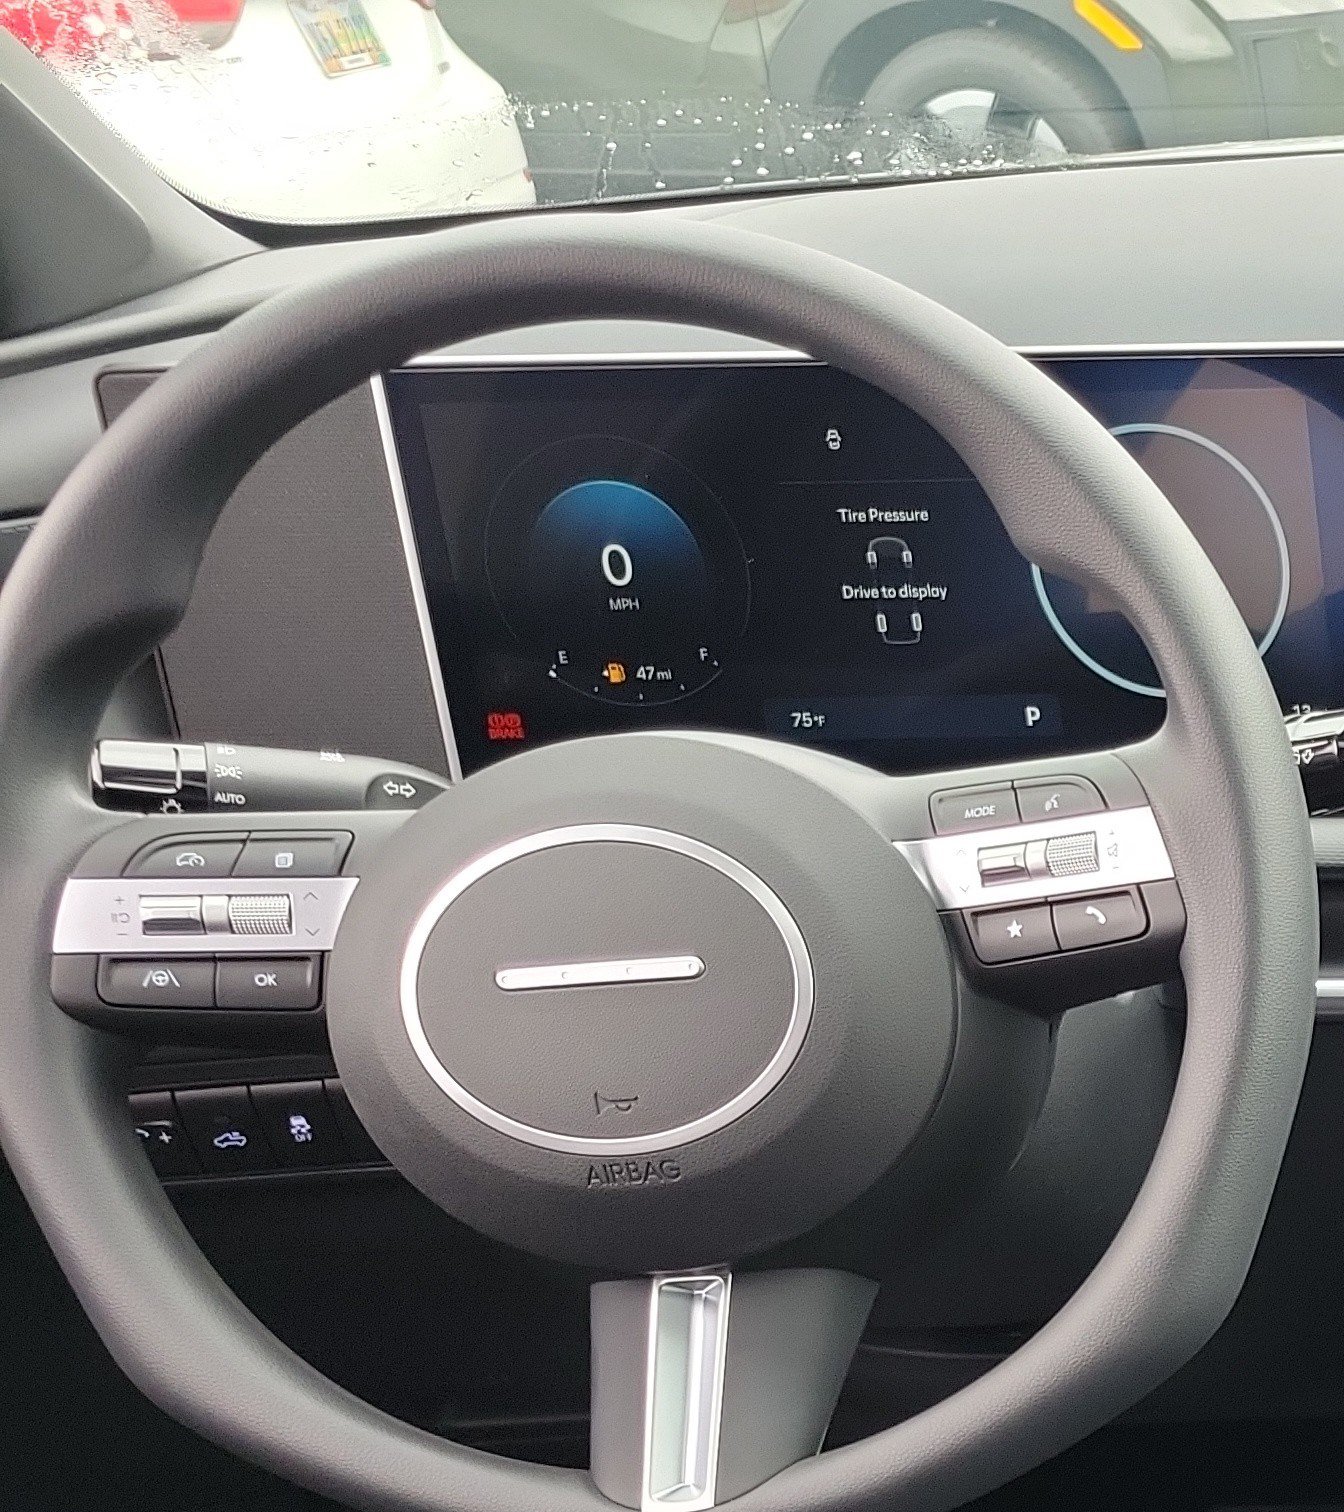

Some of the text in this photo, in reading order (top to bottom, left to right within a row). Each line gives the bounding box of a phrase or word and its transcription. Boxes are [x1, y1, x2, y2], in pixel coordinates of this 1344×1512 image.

[837, 508, 929, 522] Tire Pressure
[602, 543, 633, 587] 0
[842, 584, 948, 602] Drive to display
[609, 597, 640, 612] MPH
[558, 650, 569, 665] E
[699, 647, 709, 661] F
[635, 665, 673, 681] 47 mi
[1026, 706, 1041, 728] P
[214, 791, 246, 805] AUTO
[964, 804, 996, 819] MODE
[254, 974, 278, 987] OK
[587, 1159, 682, 1189] AIRBAG
